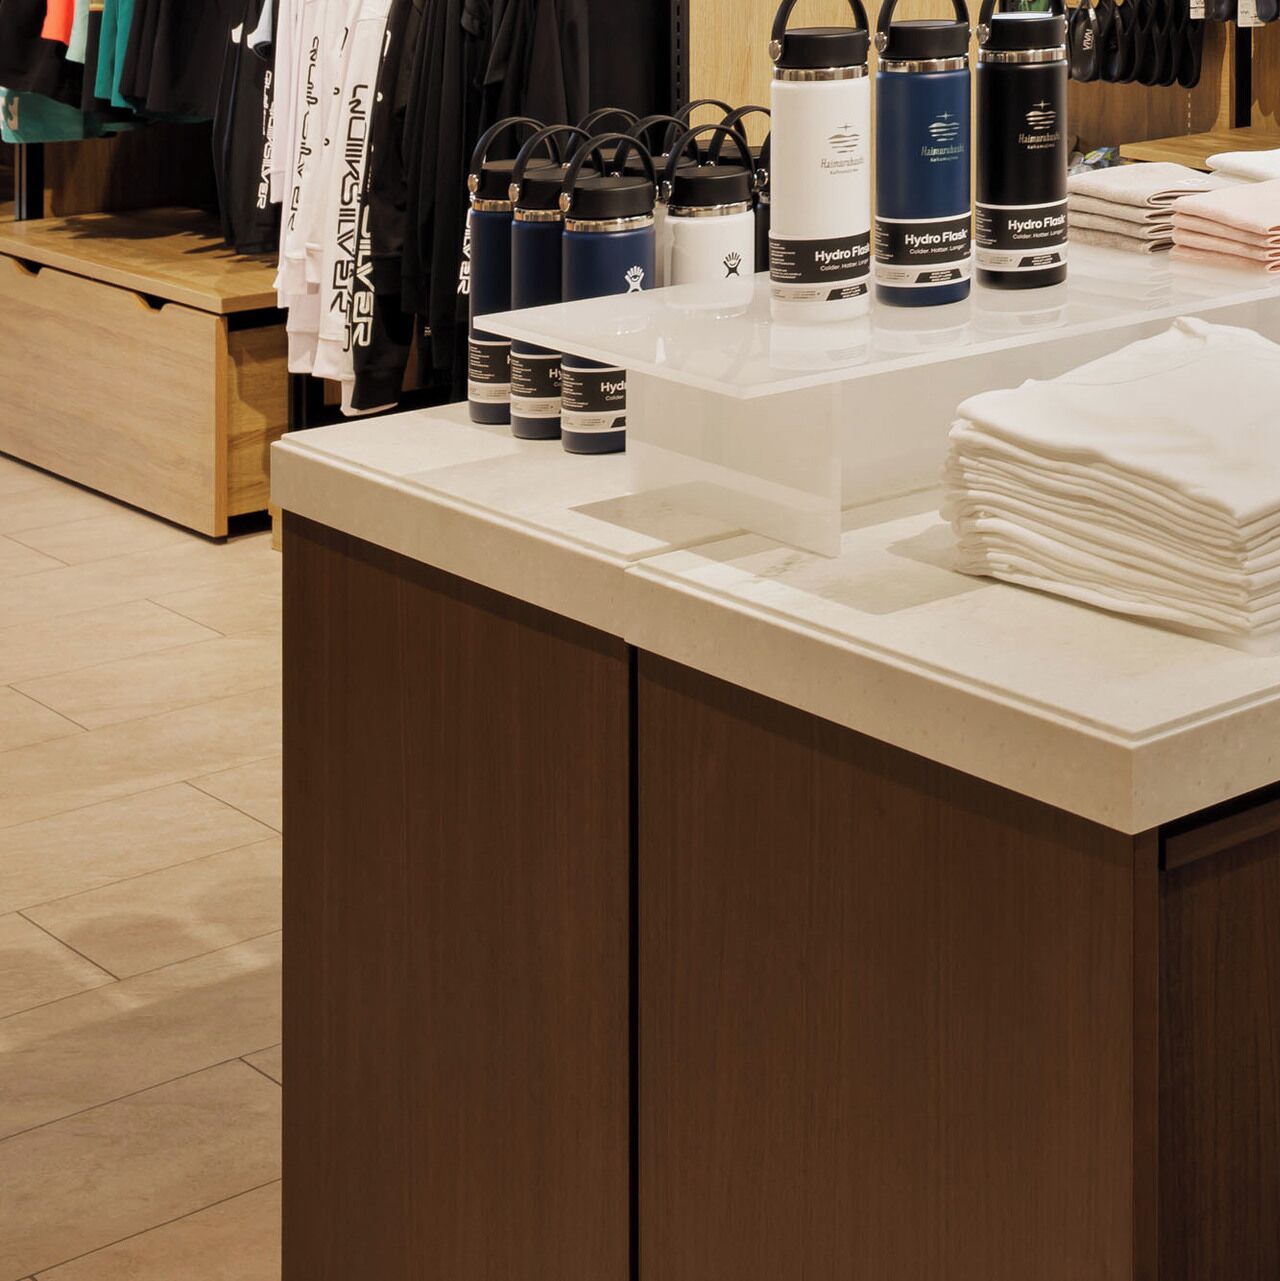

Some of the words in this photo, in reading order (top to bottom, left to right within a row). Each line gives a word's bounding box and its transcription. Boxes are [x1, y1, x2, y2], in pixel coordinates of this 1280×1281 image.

[1008, 218, 1043, 232] Hydro
[1043, 214, 1065, 228] Flask
[905, 232, 942, 247] Hydro
[942, 228, 967, 242] Flask
[814, 248, 851, 264] Hydro
